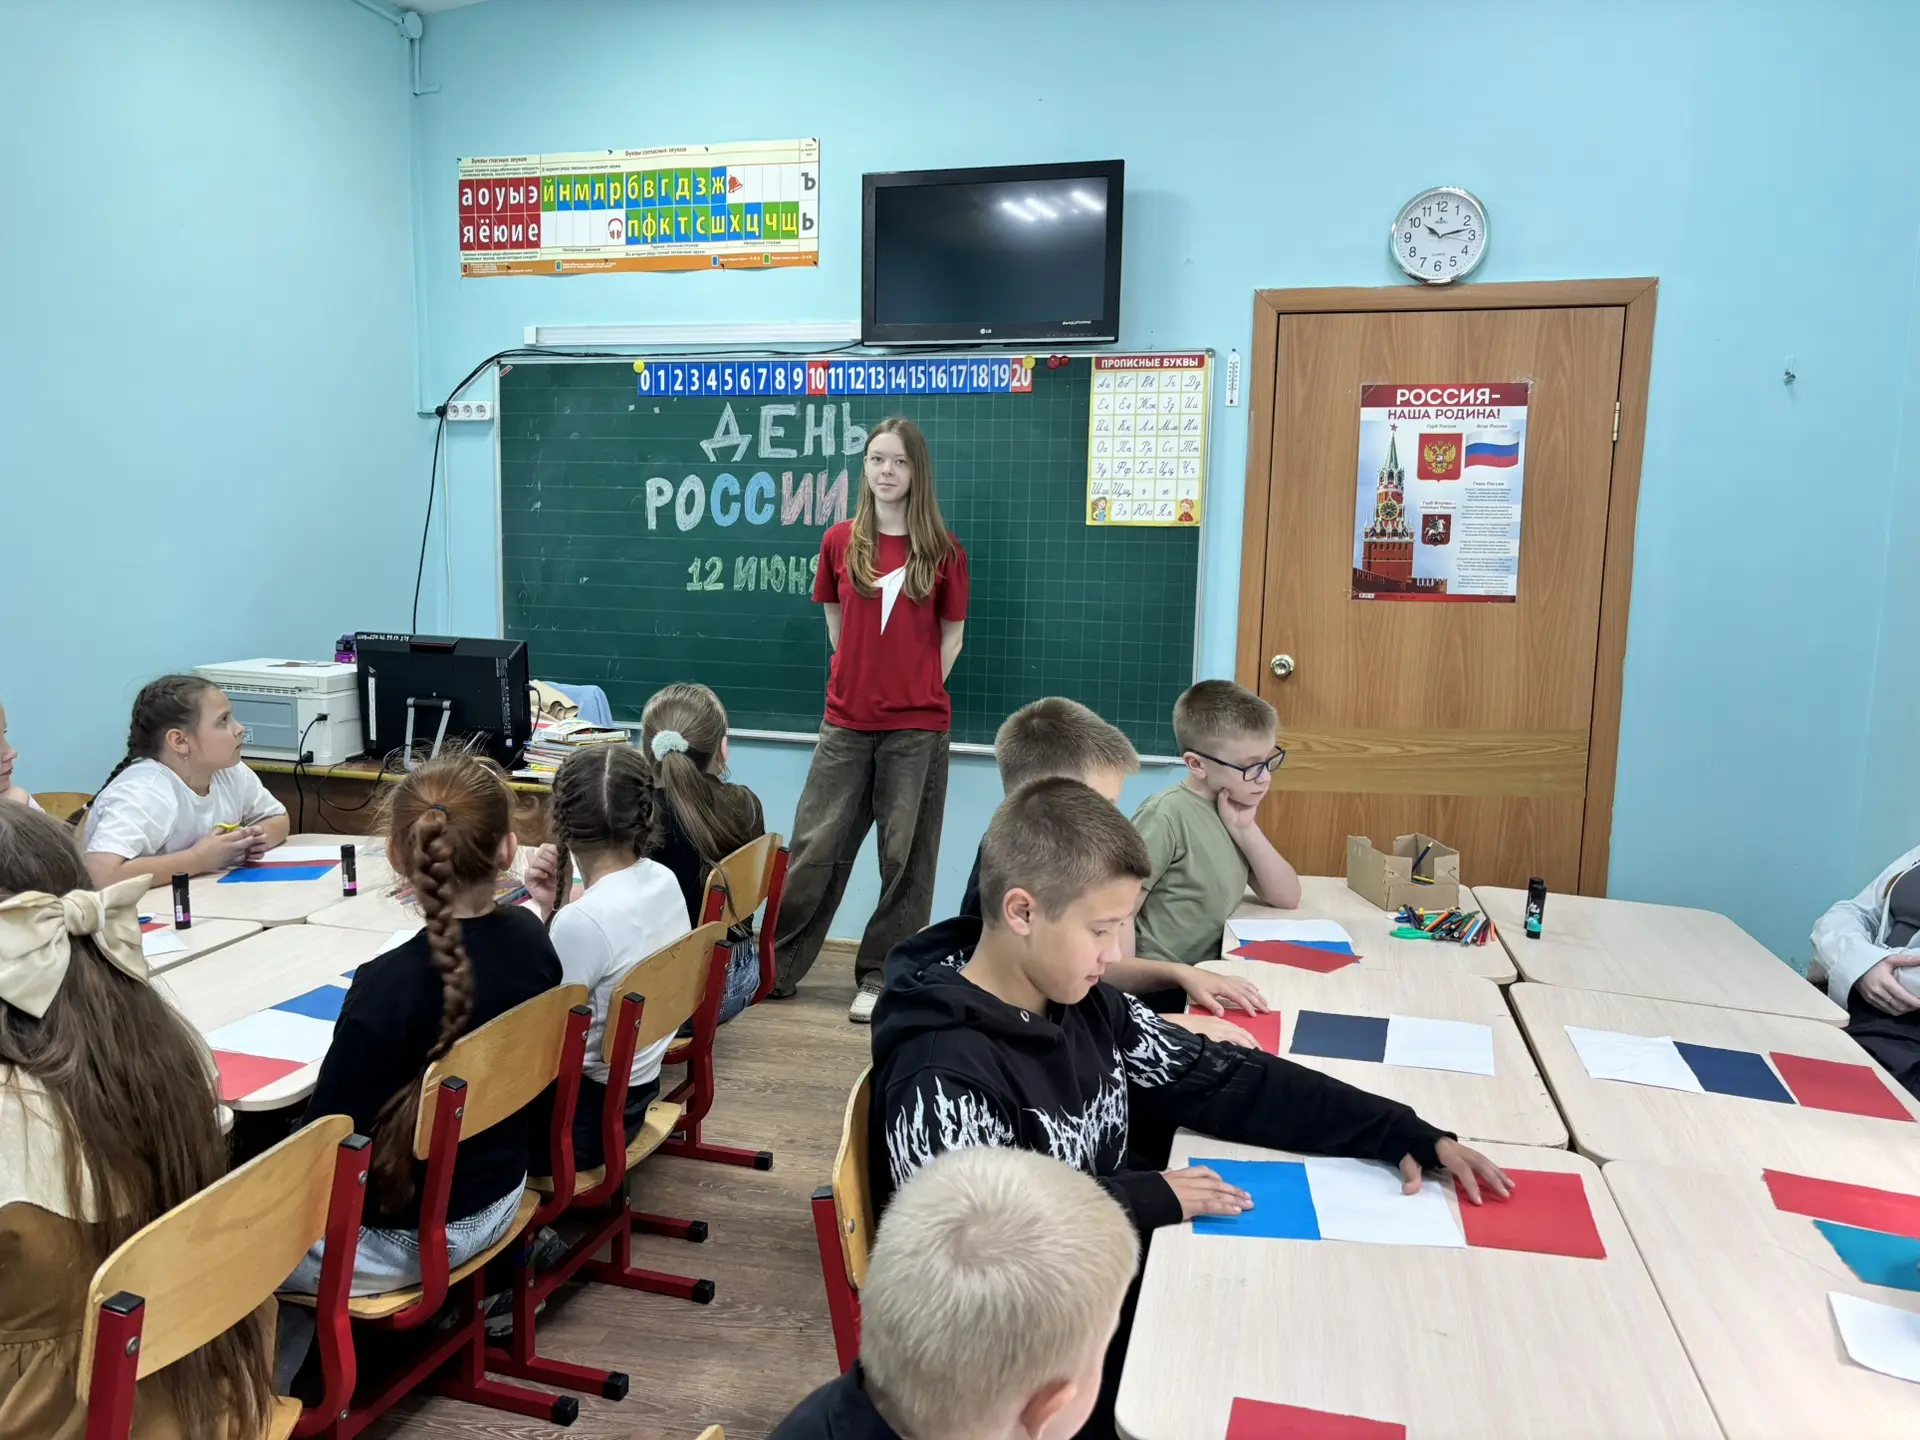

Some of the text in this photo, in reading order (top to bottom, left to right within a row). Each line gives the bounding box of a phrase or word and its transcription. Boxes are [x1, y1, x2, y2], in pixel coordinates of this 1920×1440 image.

[462, 188, 472, 206] а
[478, 188, 489, 204] о
[496, 187, 506, 212] у
[510, 186, 524, 204] ы
[528, 186, 538, 204] э
[544, 179, 554, 202] й
[560, 184, 570, 202] н
[575, 184, 589, 202] м
[594, 183, 604, 200] л
[610, 182, 622, 206] р
[628, 175, 638, 199] б
[644, 180, 654, 198] в
[661, 178, 669, 196] г
[676, 178, 690, 200] д
[696, 178, 706, 195] з
[712, 176, 725, 193] ж
[1422, 206, 1432, 216] 11
[1436, 201, 1448, 212] 12
[1455, 204, 1460, 215] 1
[1409, 217, 1420, 228] 10
[1464, 215, 1471, 226] 2
[463, 226, 474, 243] я
[479, 219, 490, 242] ё
[494, 224, 508, 242] ю
[512, 224, 522, 242] и
[528, 223, 538, 241] е
[628, 220, 638, 237] п
[643, 212, 656, 242] ф
[660, 218, 670, 235] к
[678, 217, 688, 234] т
[696, 216, 706, 234] с
[712, 216, 724, 234] ш
[730, 214, 740, 232] х
[746, 214, 758, 236] ц
[766, 213, 777, 231] ч
[782, 212, 798, 235] щ
[1404, 232, 1412, 243] 9
[1468, 230, 1476, 240] 3
[1409, 246, 1416, 258] 8
[1461, 245, 1468, 255] 4
[1420, 257, 1426, 268] 7
[1434, 261, 1442, 271] 6
[1450, 256, 1456, 266] 5
[1102, 358, 1198, 368] ПРОПИСНЫЕ БУКВЫ
[640, 364, 1031, 391] 0 1 2 3 4 5 6 7 8 9 10 11 12 13 14 15 16 17 18 19 20
[1396, 388, 1500, 406] РОССИЯ-
[1388, 408, 1500, 420] НАША РОДИНА!
[700, 401, 868, 462] ДЕНЬ
[646, 468, 848, 532] РОССИИ
[686, 556, 724, 591] 12
